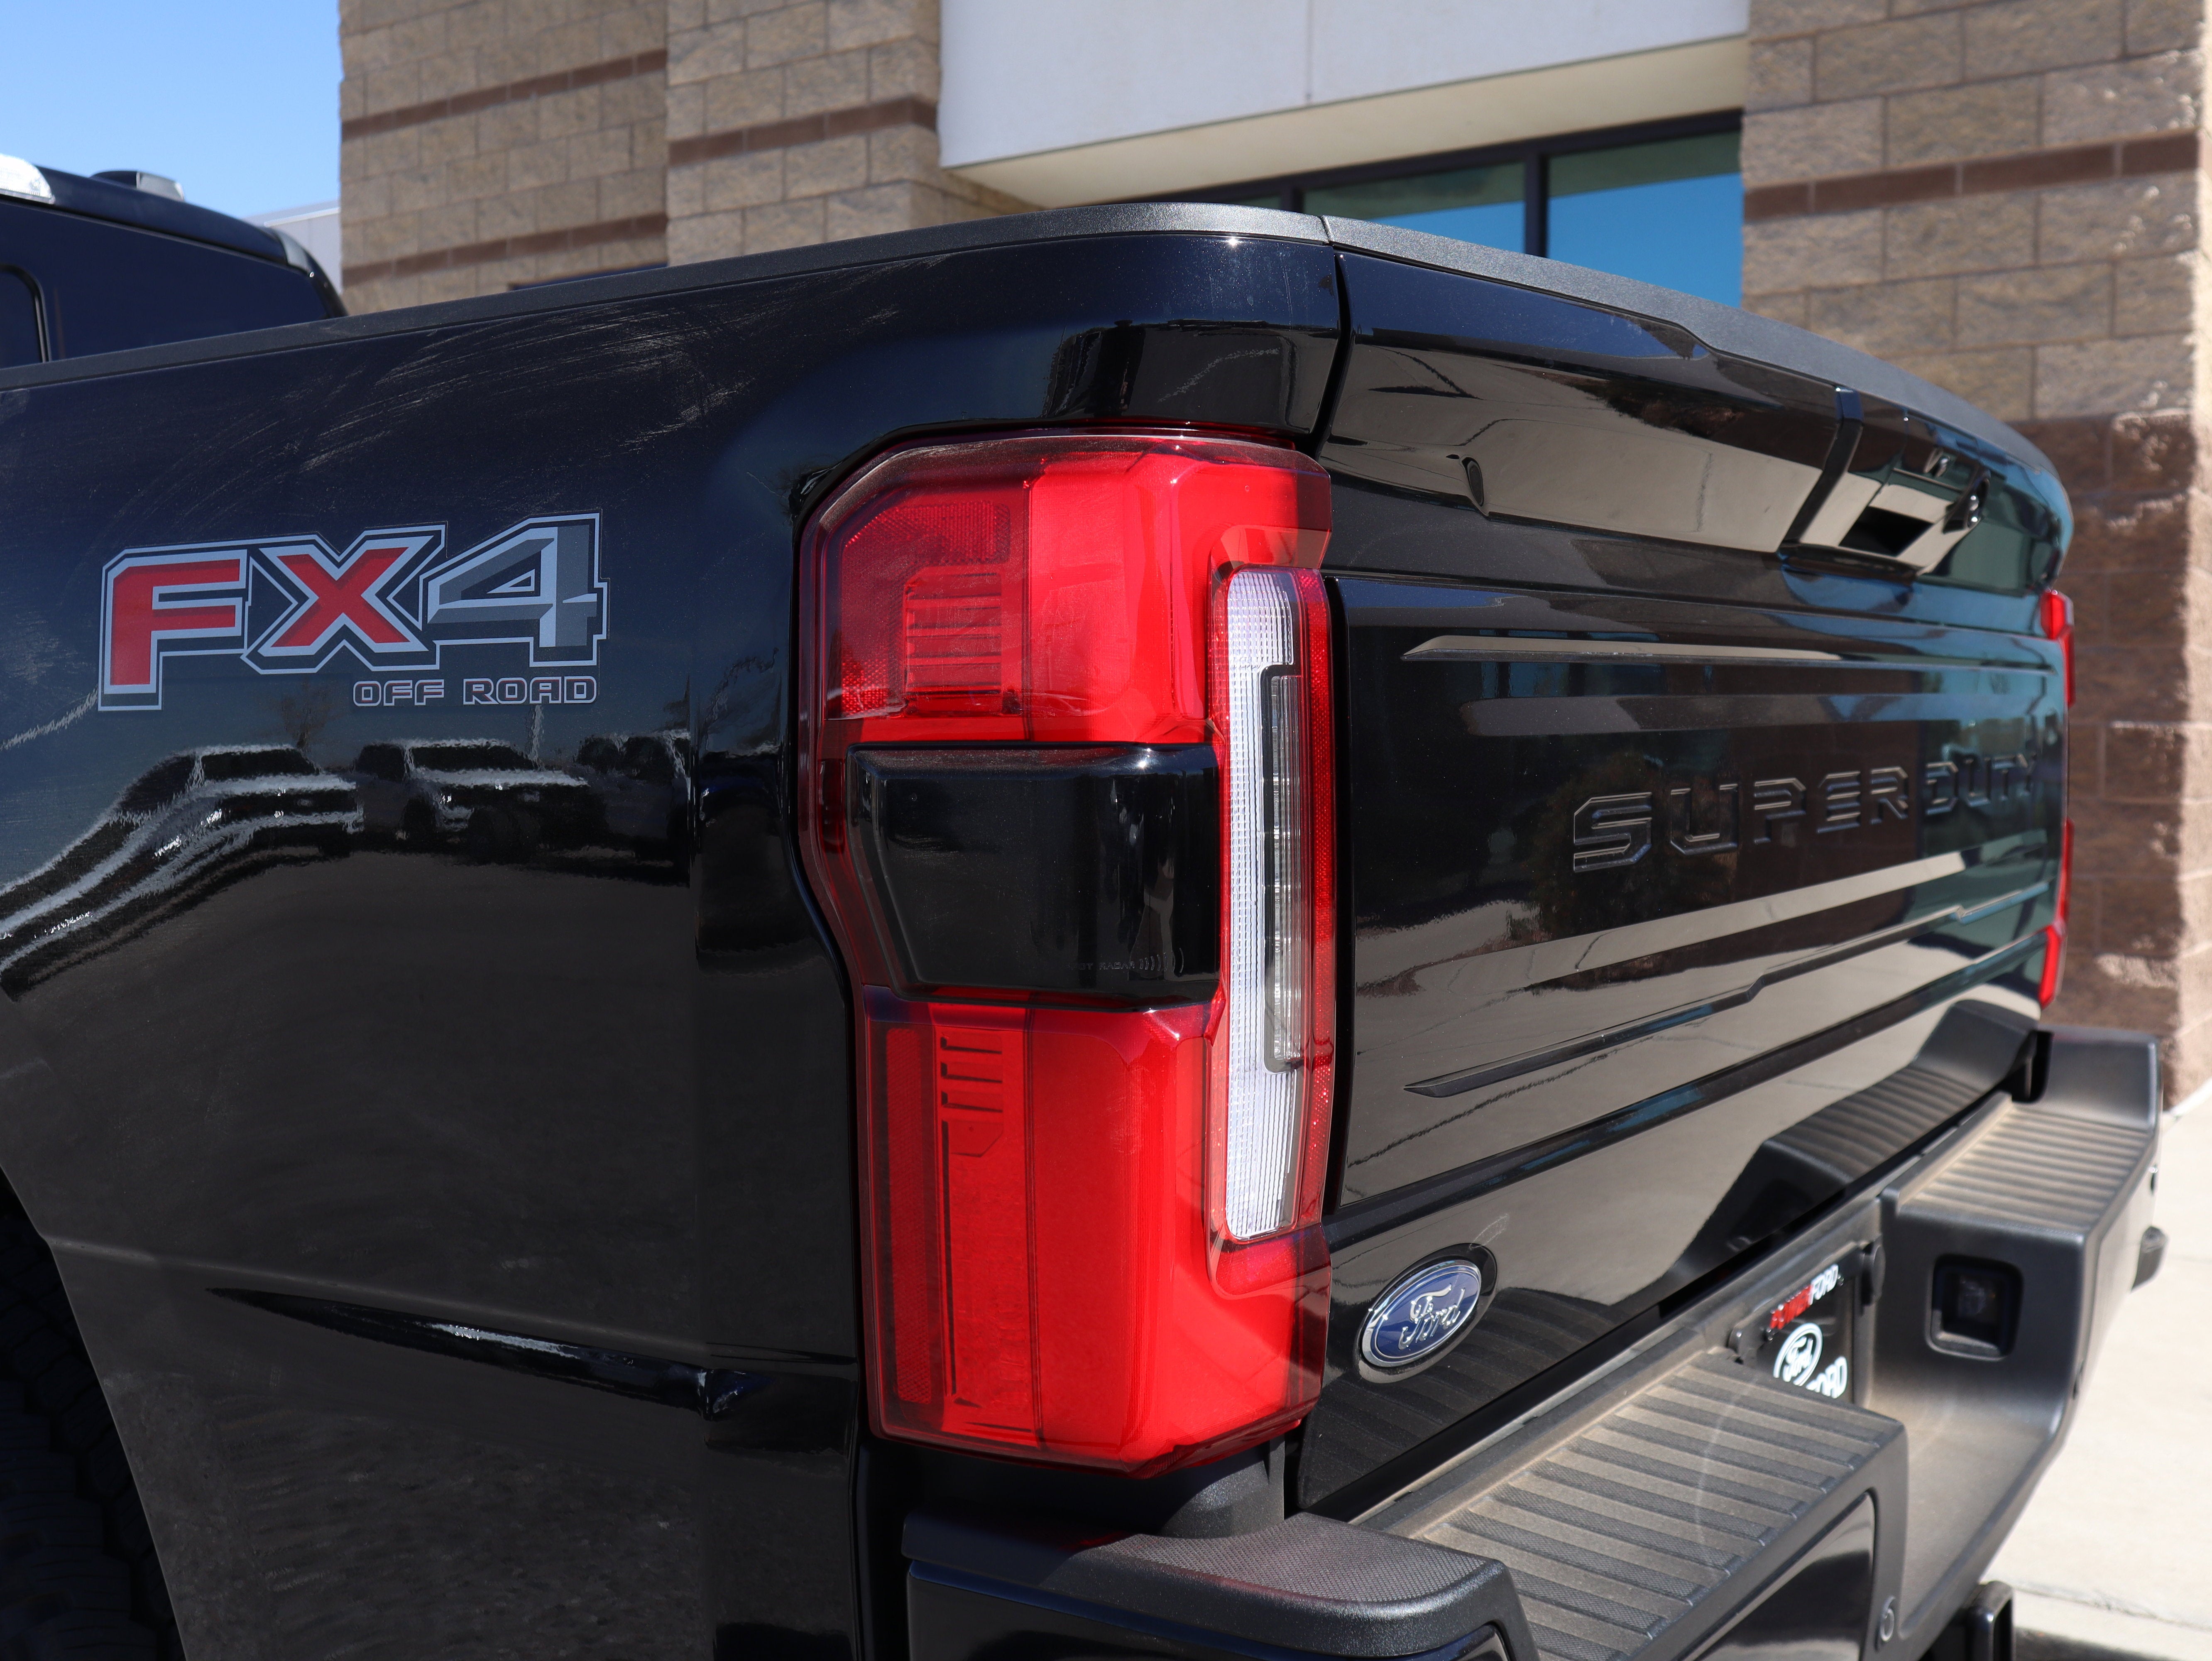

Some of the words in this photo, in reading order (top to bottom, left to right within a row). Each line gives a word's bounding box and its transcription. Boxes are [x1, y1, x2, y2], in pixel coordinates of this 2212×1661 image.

[98, 510, 609, 711] FX4
[353, 679, 445, 706] OFF
[463, 676, 597, 706] ROAD
[1573, 766, 1909, 872] SUPER
[1926, 752, 2037, 816] DUTY
[1397, 1283, 1466, 1350] Ford
[1808, 1263, 1839, 1306] FORD
